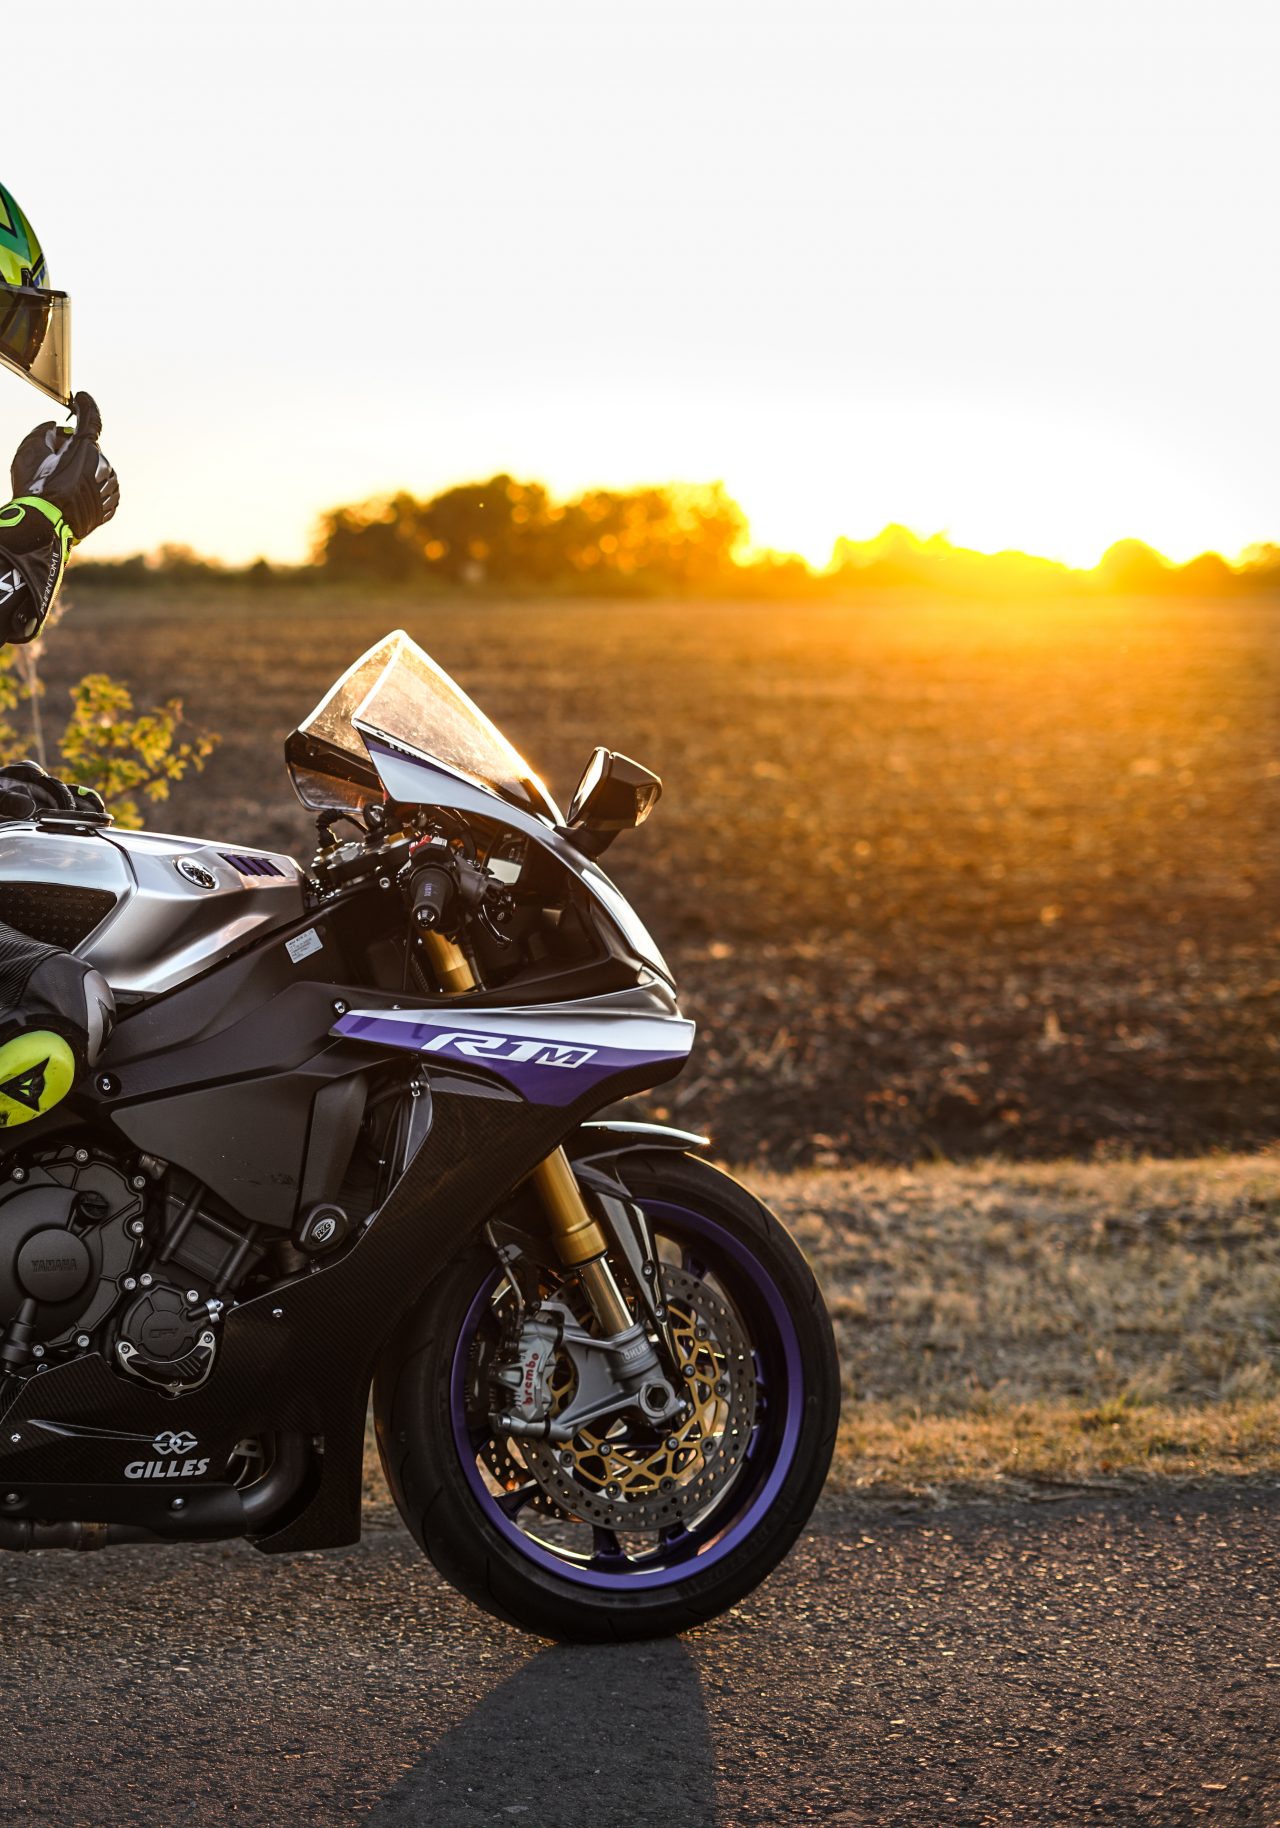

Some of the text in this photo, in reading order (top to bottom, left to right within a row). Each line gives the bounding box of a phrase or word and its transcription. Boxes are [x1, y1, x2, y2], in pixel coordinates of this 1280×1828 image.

[420, 1032, 598, 1069] R1M
[522, 1353, 539, 1406] brembo
[124, 1458, 210, 1479] GILLES
